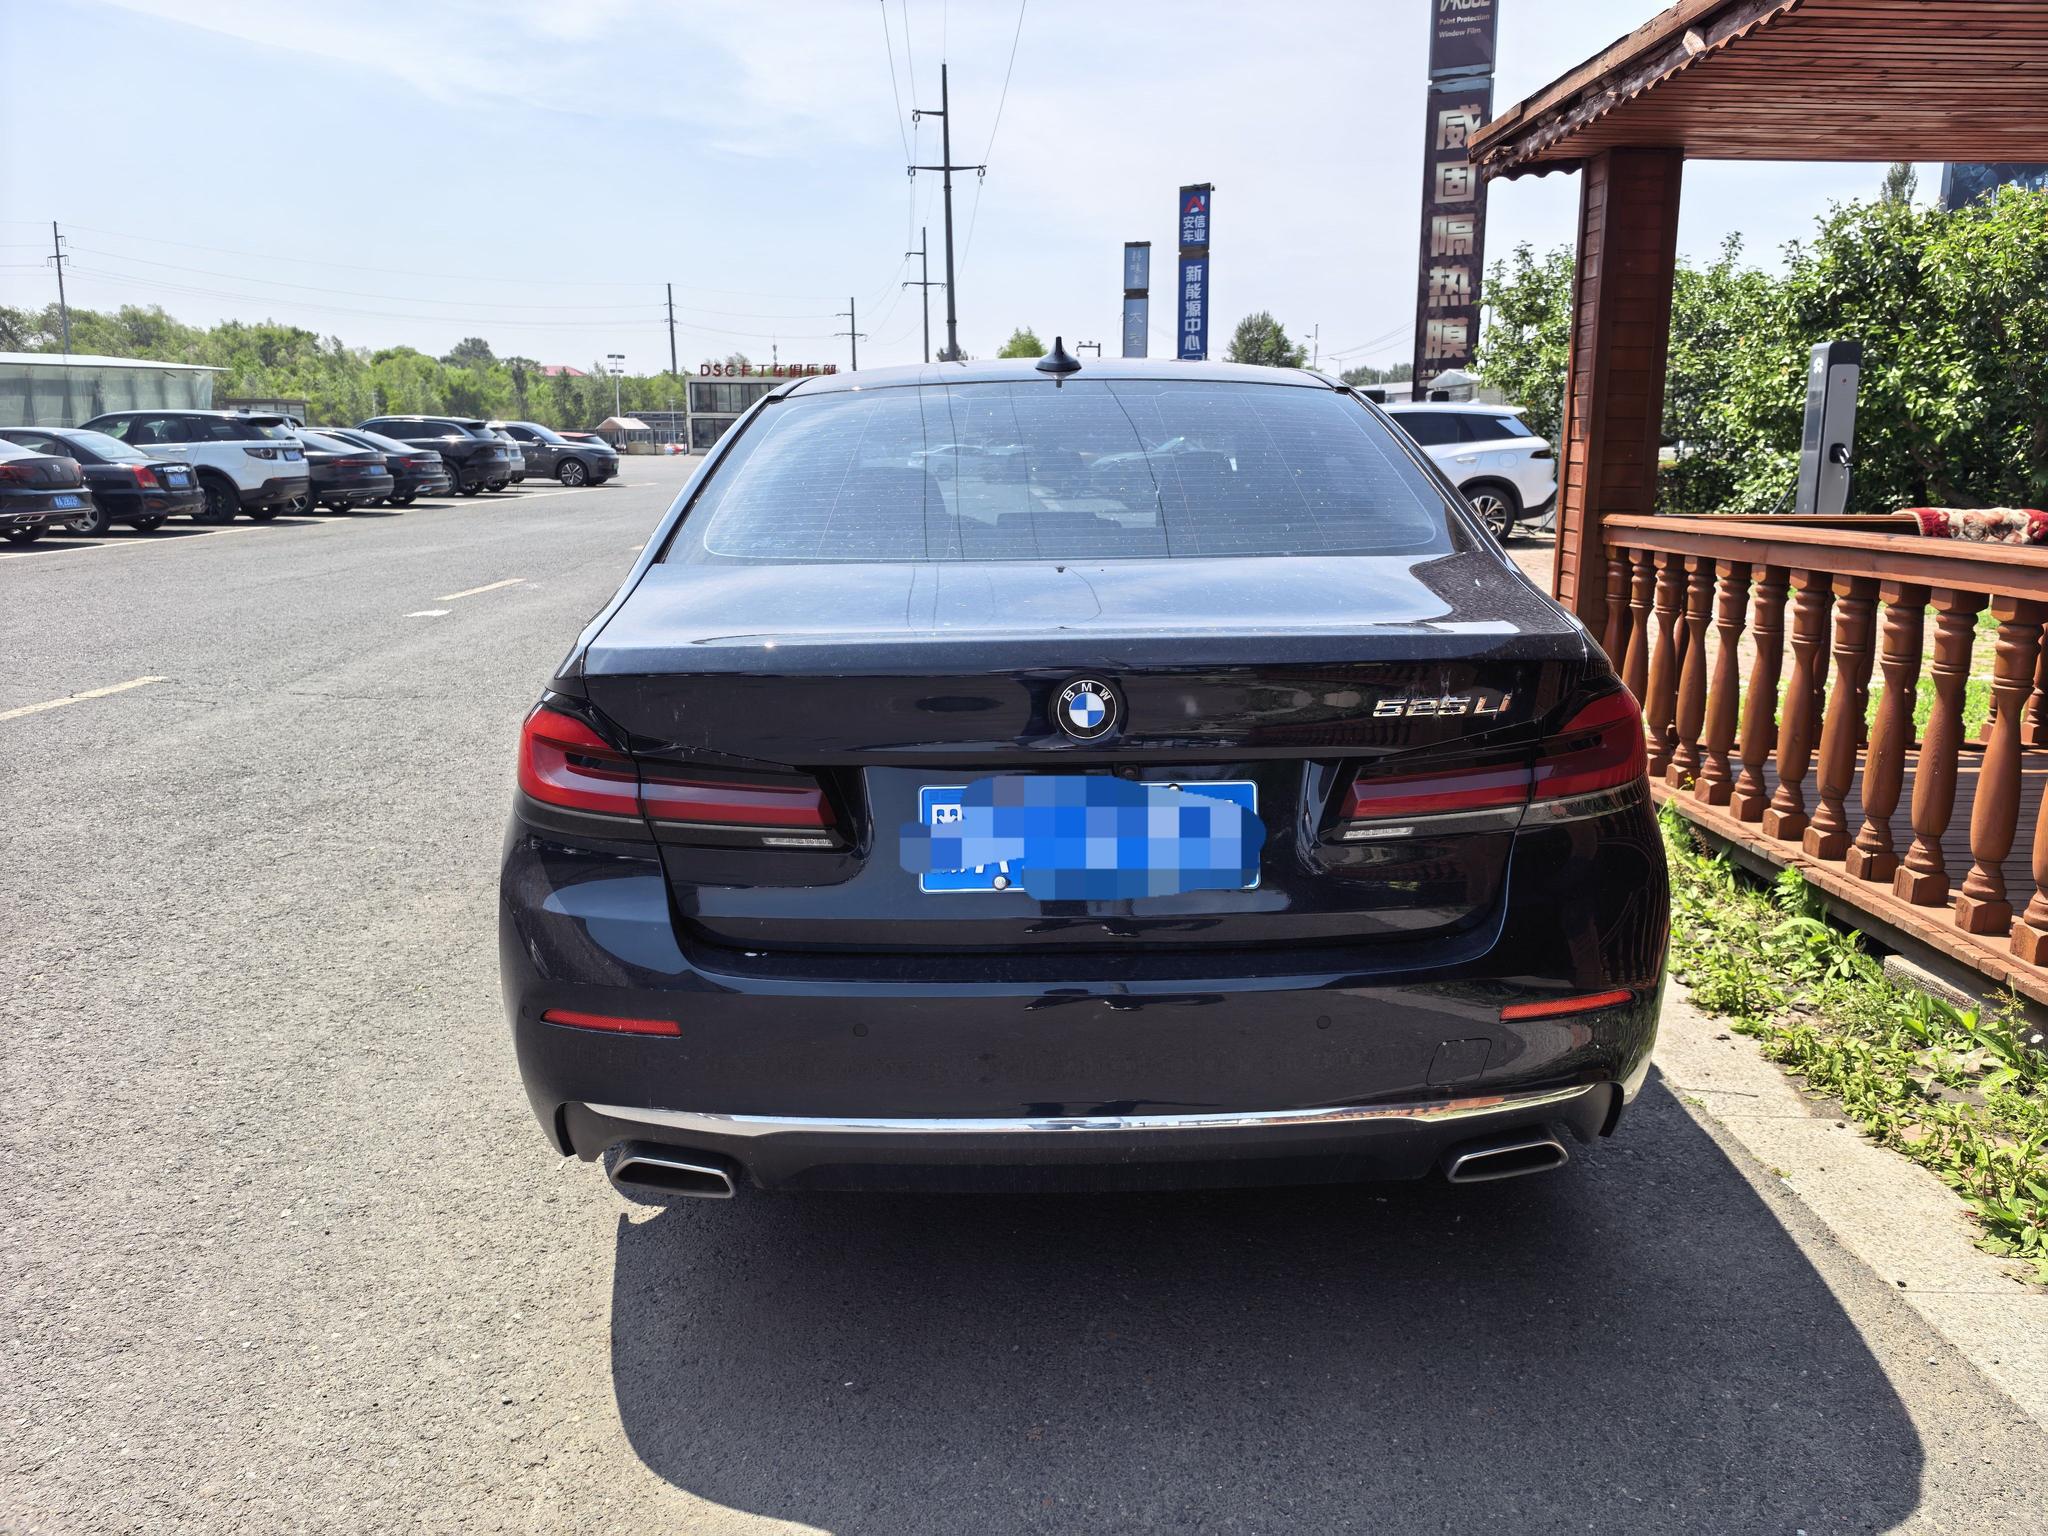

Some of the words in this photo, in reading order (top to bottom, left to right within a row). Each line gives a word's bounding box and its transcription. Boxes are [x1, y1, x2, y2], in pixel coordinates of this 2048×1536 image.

[1456, 14, 1490, 23] Protection
[1438, 29, 1466, 38] Window
[1466, 27, 1482, 35] Film
[1183, 215, 1206, 229] 安信
[1183, 229, 1206, 243] 车业
[1424, 104, 1482, 360] 威固隔热膜
[1184, 265, 1203, 350] 新能源中心
[1063, 682, 1112, 702] BMW
